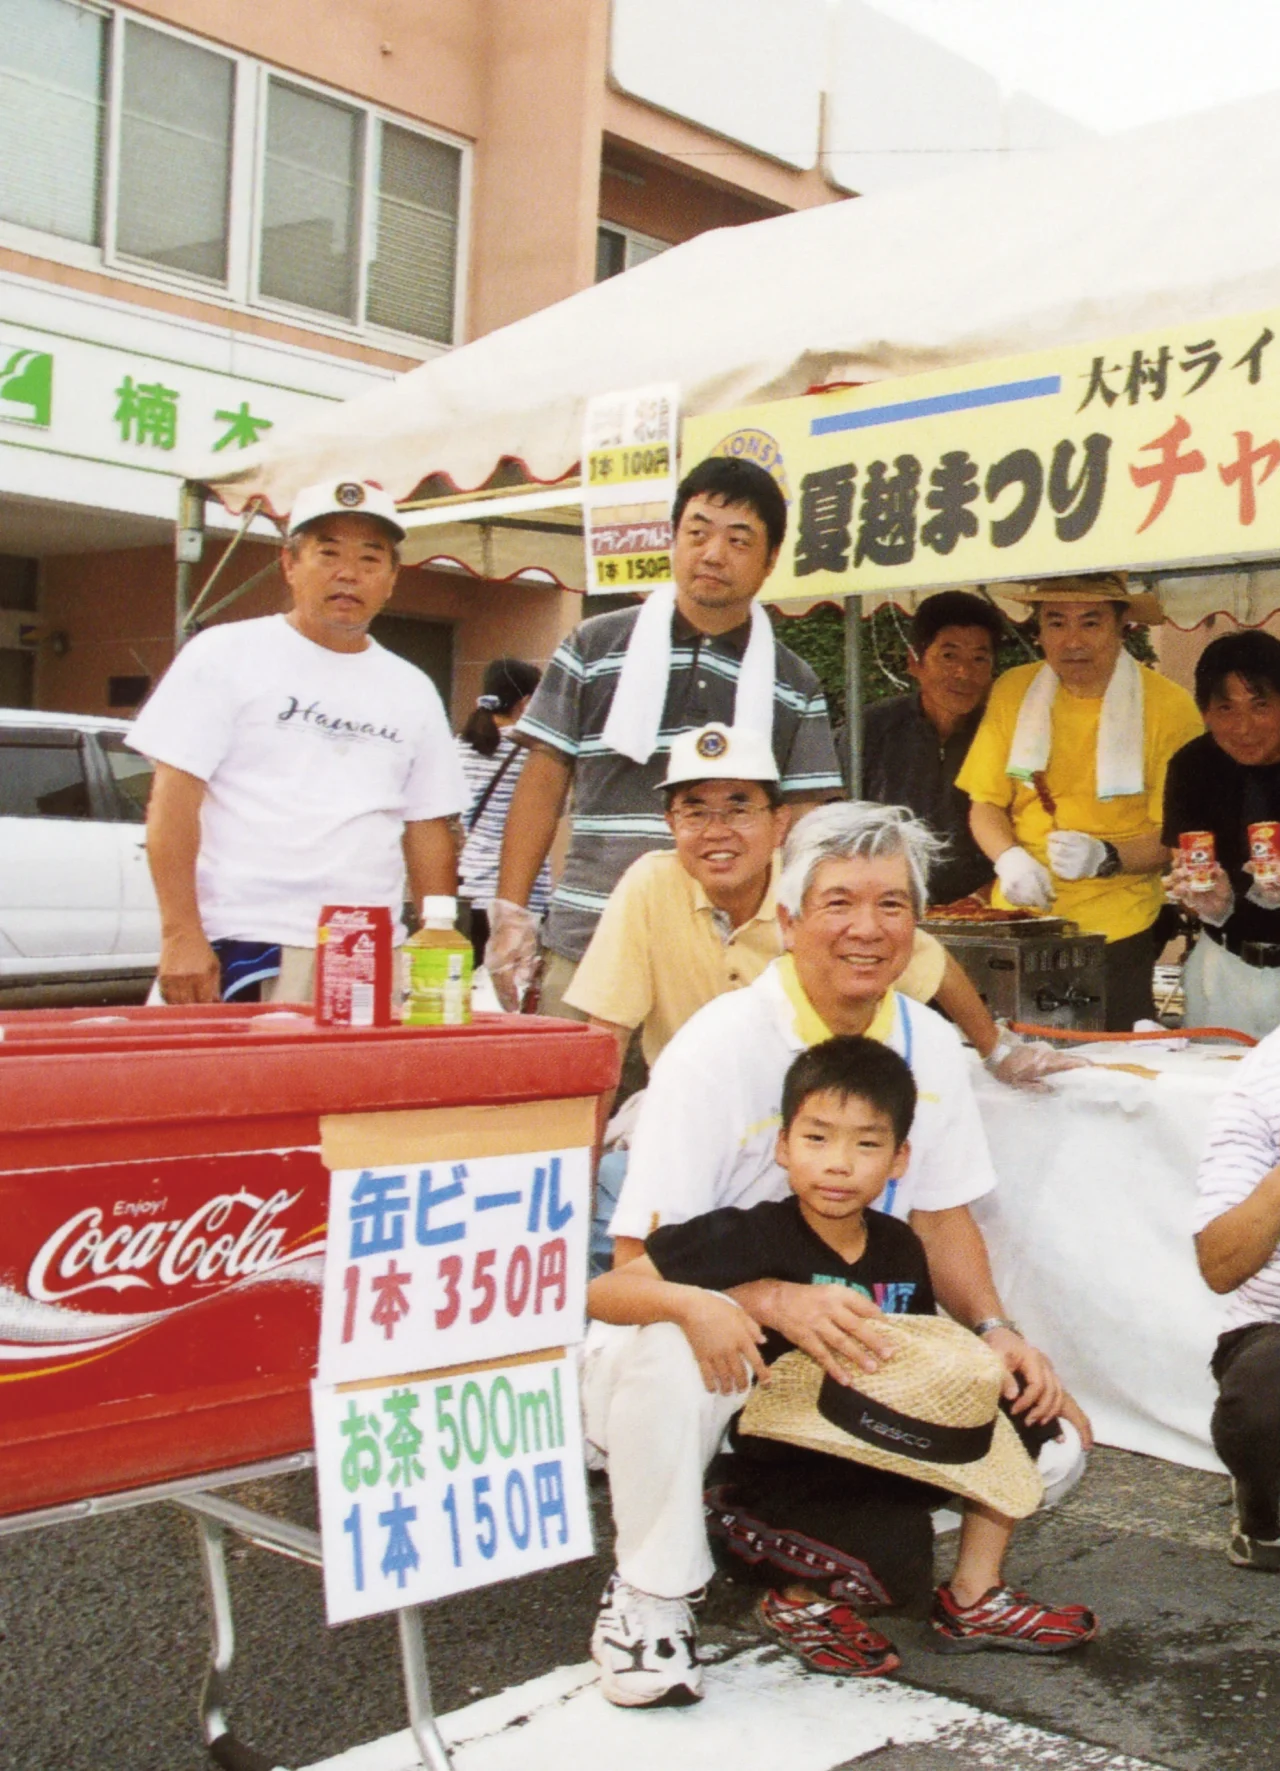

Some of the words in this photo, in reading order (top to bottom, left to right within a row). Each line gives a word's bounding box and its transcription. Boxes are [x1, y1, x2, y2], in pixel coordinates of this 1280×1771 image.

[722, 435, 775, 463] IONS
[792, 432, 1113, 578] 夏越まつり
[277, 695, 404, 744] Hawaii
[26, 1185, 308, 1302] Coca-Cola
[112, 1197, 169, 1218] Enjoy!
[349, 1156, 575, 1260] 缶ビール
[341, 1259, 412, 1344] 1本
[434, 1237, 568, 1331] 350円
[340, 1387, 426, 1493] お茶
[434, 1367, 566, 1472] 500ml
[343, 1491, 420, 1592] 1本
[441, 1460, 569, 1568] 150円
